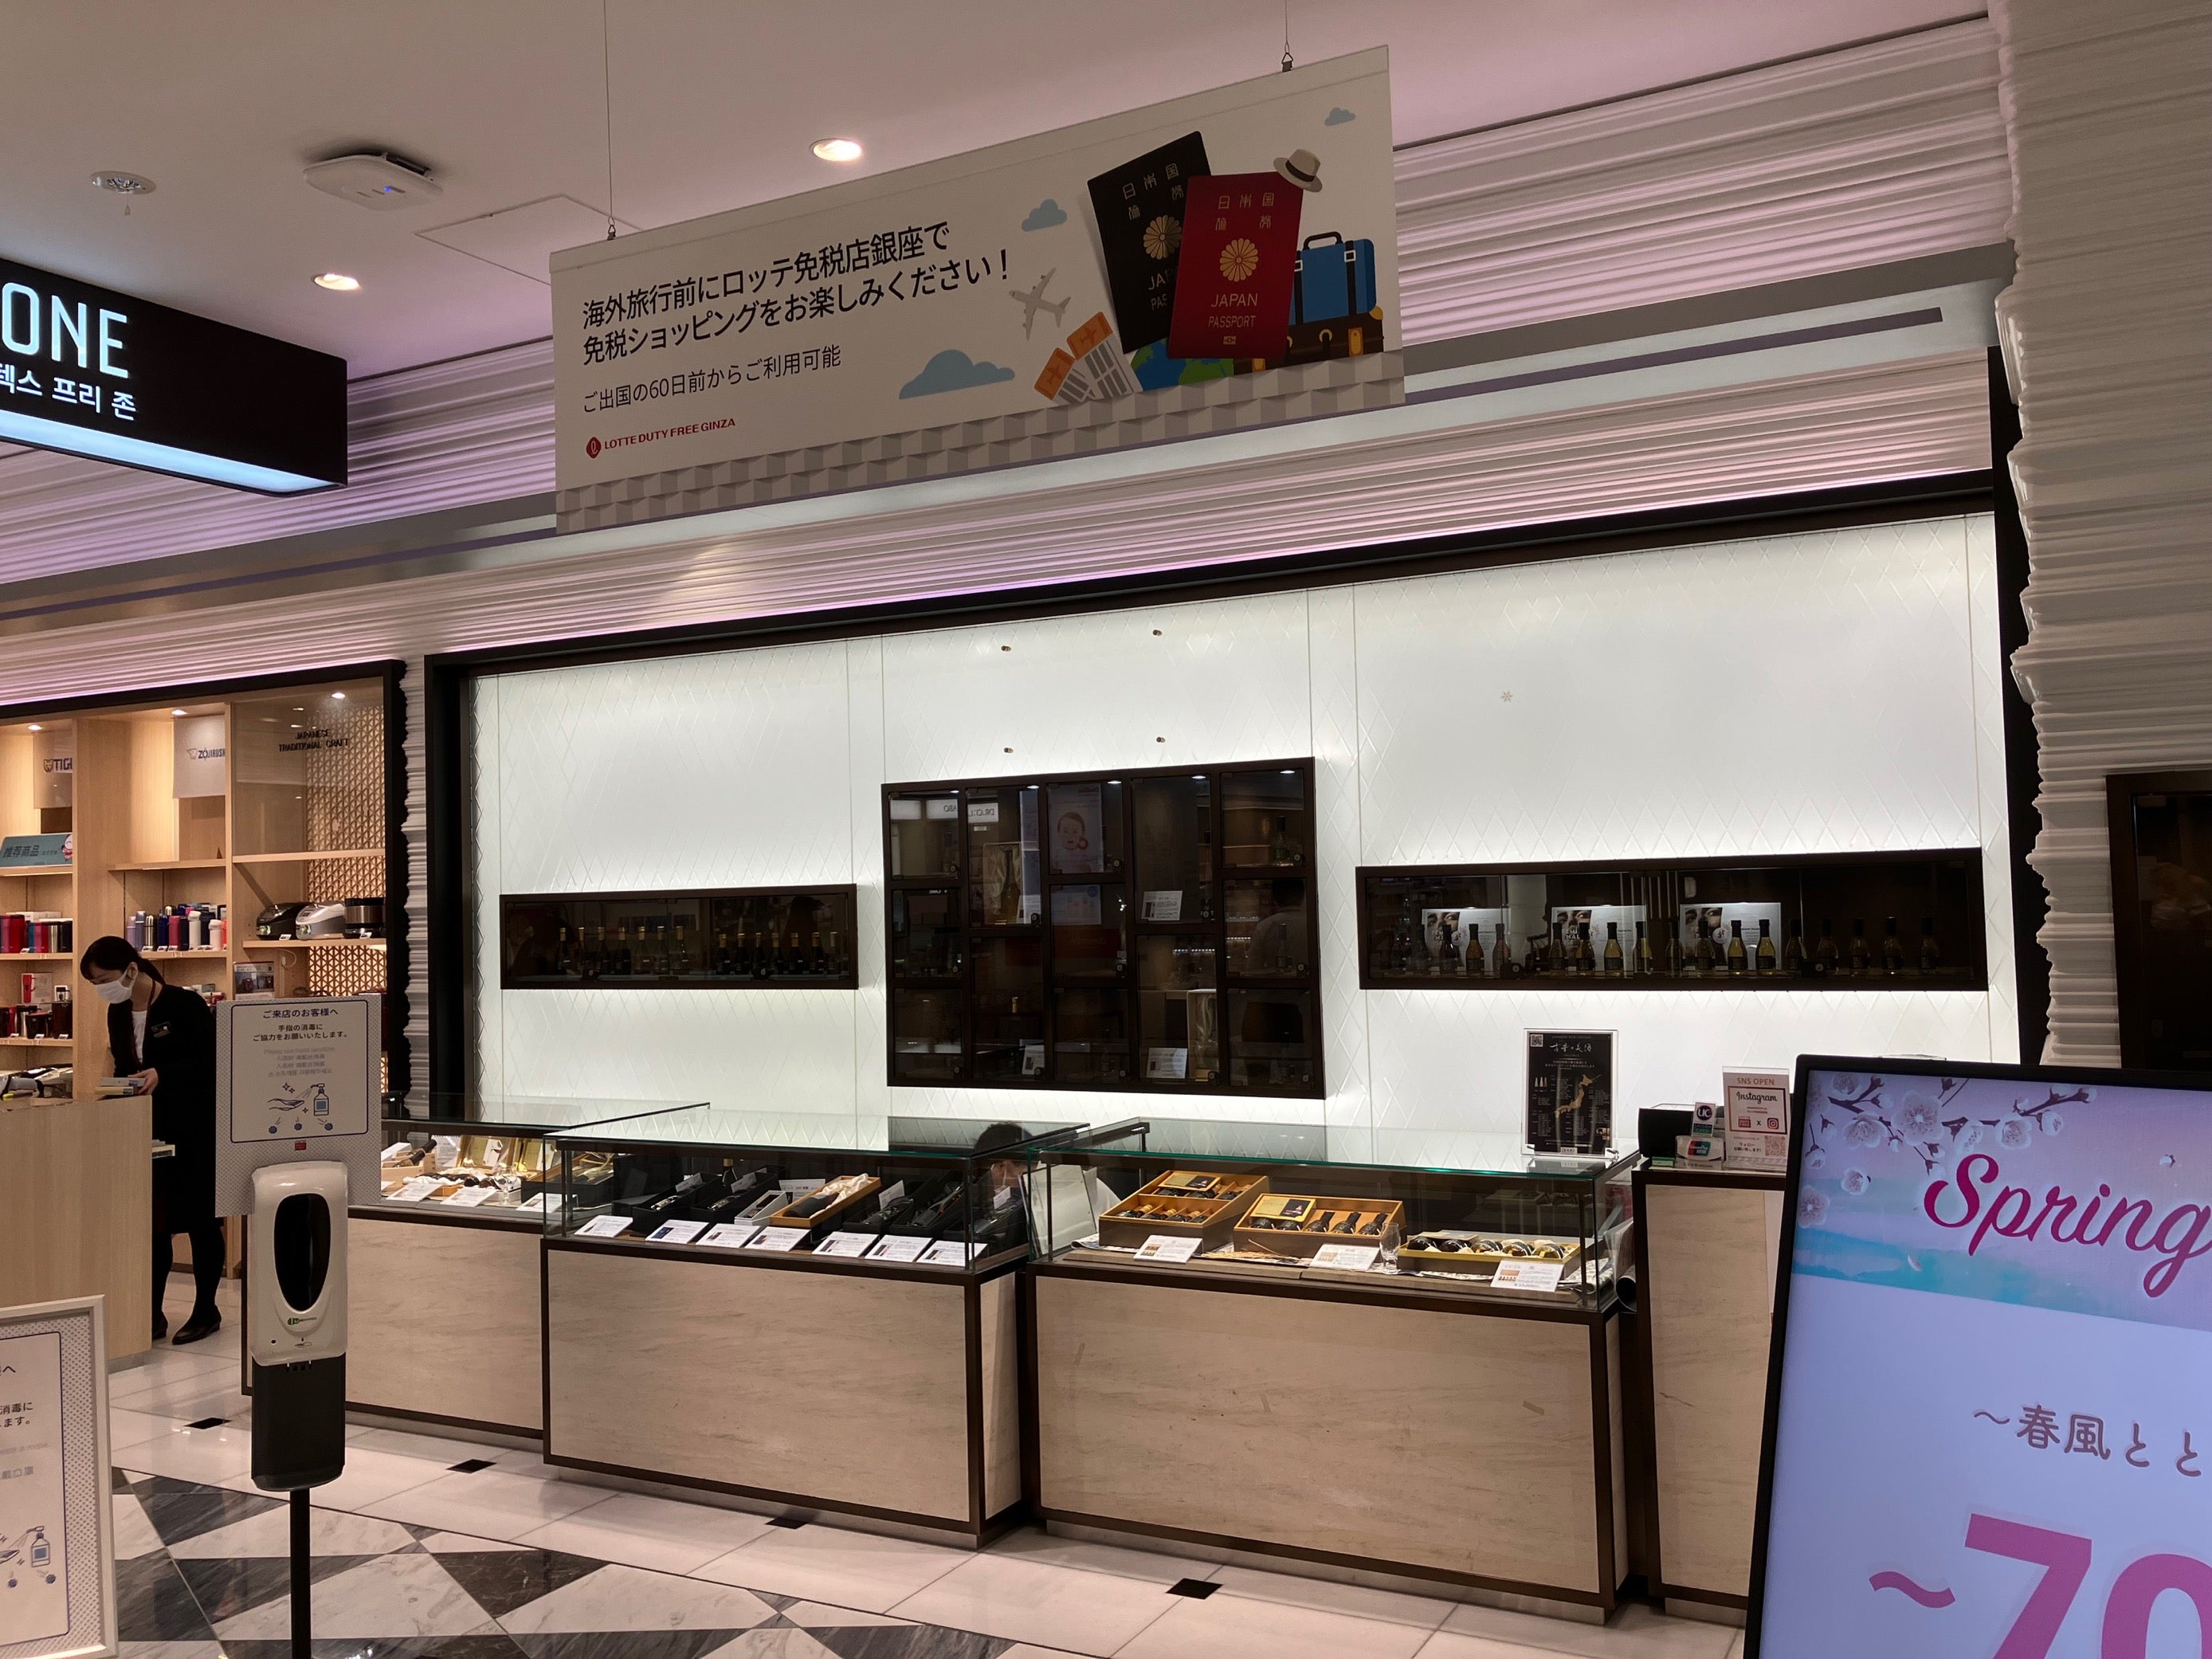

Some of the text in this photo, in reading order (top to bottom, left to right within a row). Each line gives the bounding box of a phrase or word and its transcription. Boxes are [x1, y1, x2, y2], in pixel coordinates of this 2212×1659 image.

[582, 221, 950, 330] 海外旅行前にロッテ免税店銀座で
[582, 248, 1010, 367] 免税ショッピングをお楽しみください！
[1210, 292, 1258, 308] JAPAN
[1208, 315, 1257, 328] PASSPORT
[583, 343, 842, 413] ご出国の60日前からご利用可能
[52, 377, 101, 414] 프리
[111, 391, 139, 421] 존
[604, 418, 736, 449] LOTTE DUTY FREE GINZA
[295, 729, 330, 740] JAPANESE
[278, 738, 350, 753] TRADITIONAL CRAFT
[262, 1007, 339, 1019] ご来店のお客様へ
[277, 1023, 323, 1033] 手指の消毒に
[252, 1030, 347, 1042] ご協力をお願いいたします。
[1735, 1091, 1778, 1104] Instagram
[1697, 1108, 1712, 1118] UC
[1924, 1153, 2212, 1298] Spring
